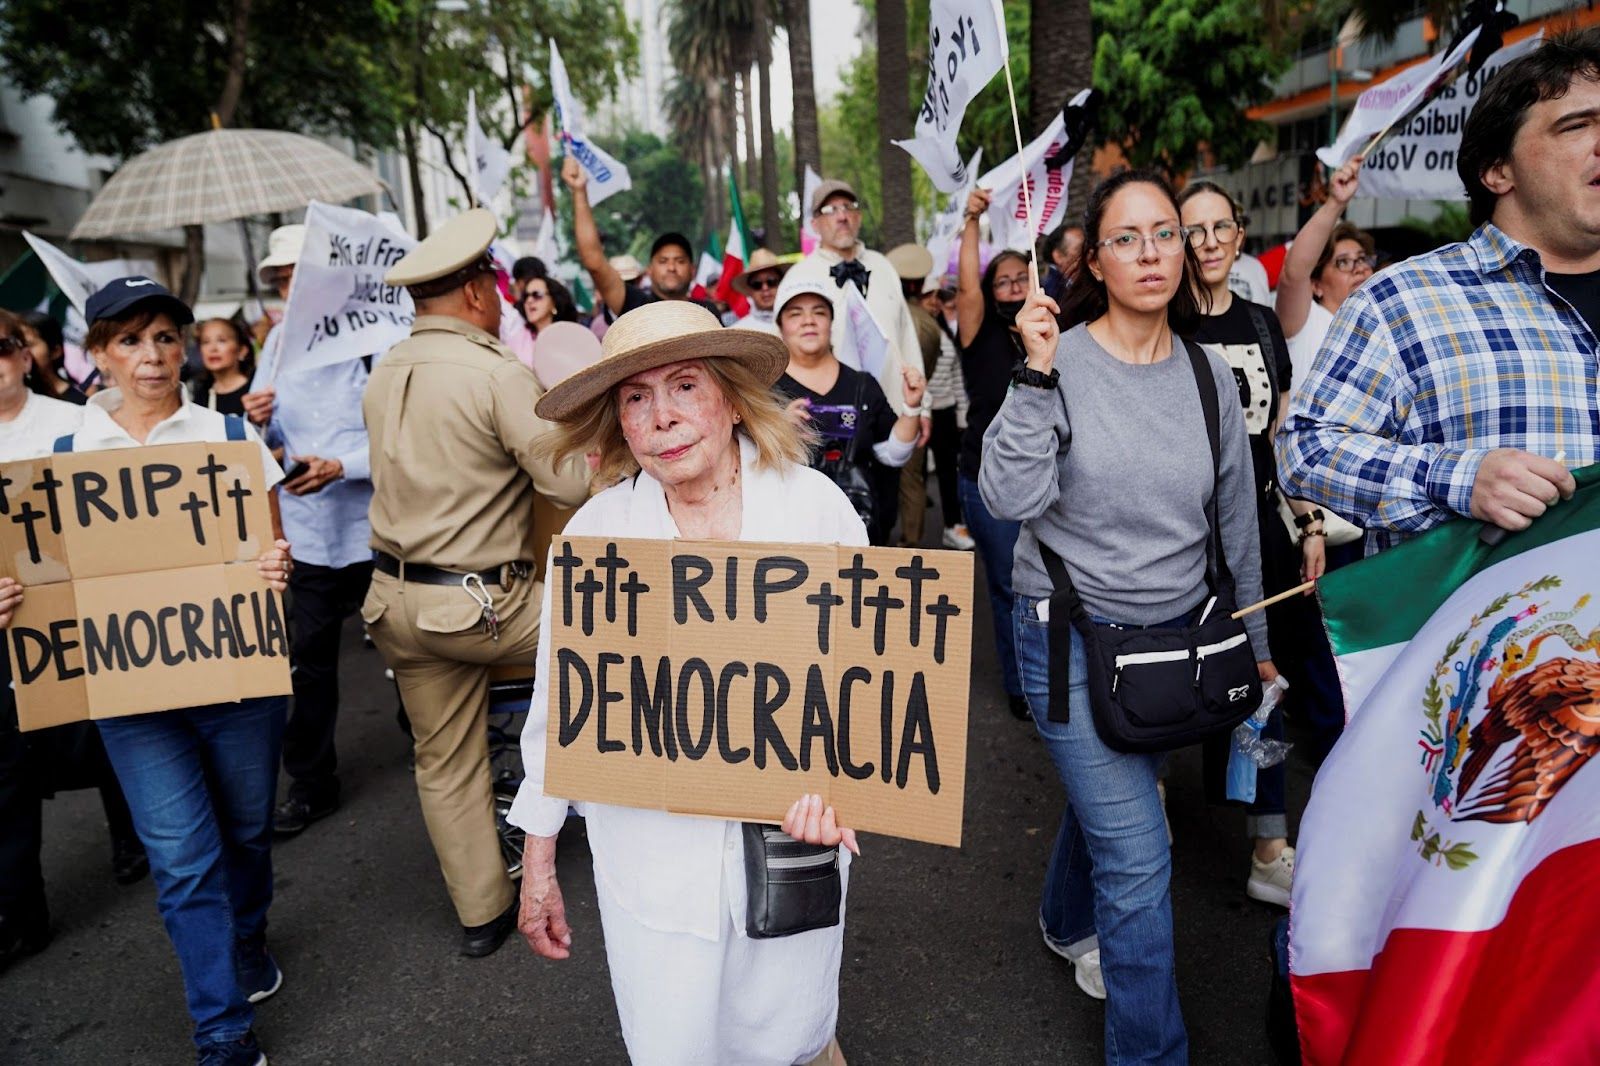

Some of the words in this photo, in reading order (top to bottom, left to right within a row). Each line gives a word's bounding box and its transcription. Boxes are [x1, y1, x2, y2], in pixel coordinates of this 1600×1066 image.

[373, 238, 405, 267] Fra
[345, 310, 378, 331] no
[72, 464, 182, 527] RIP
[671, 554, 809, 624] RIP
[11, 588, 289, 685] DEMOCRACIA
[557, 647, 941, 795] DEMOCRACIA
